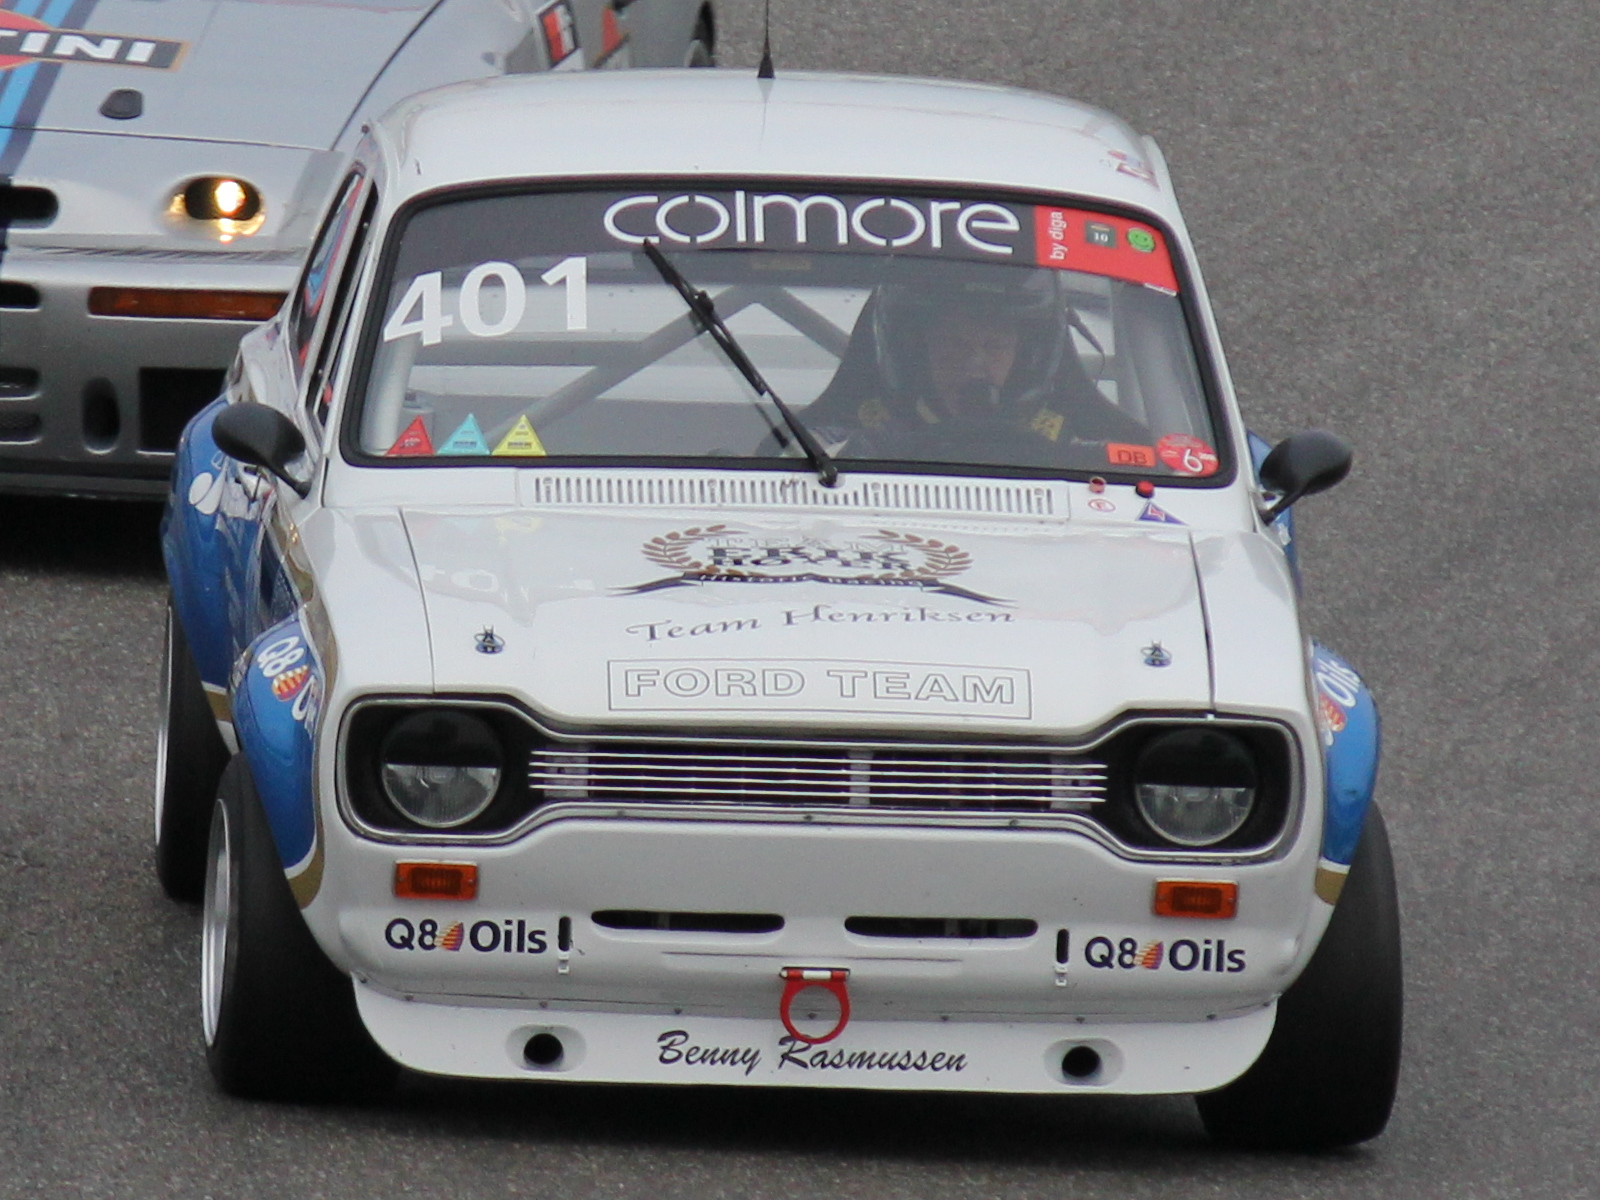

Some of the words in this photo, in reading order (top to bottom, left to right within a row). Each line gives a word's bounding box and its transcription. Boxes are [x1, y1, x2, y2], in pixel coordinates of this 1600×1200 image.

[602, 189, 1021, 255] colmore
[1047, 211, 1068, 240] diga
[1050, 240, 1069, 261] by
[382, 255, 588, 347] 401
[1116, 449, 1148, 465] DB
[625, 614, 762, 643] Team
[781, 603, 1016, 628] Henriksen
[256, 636, 305, 679] Q8
[624, 667, 806, 698] FORD
[826, 668, 1015, 705] TEAM
[384, 917, 439, 951] Q8
[469, 919, 548, 955] Oils
[1084, 935, 1138, 970] Q8
[1168, 938, 1247, 973] Oils
[657, 1029, 762, 1077] Benny
[777, 1033, 968, 1073] Rasmussen
